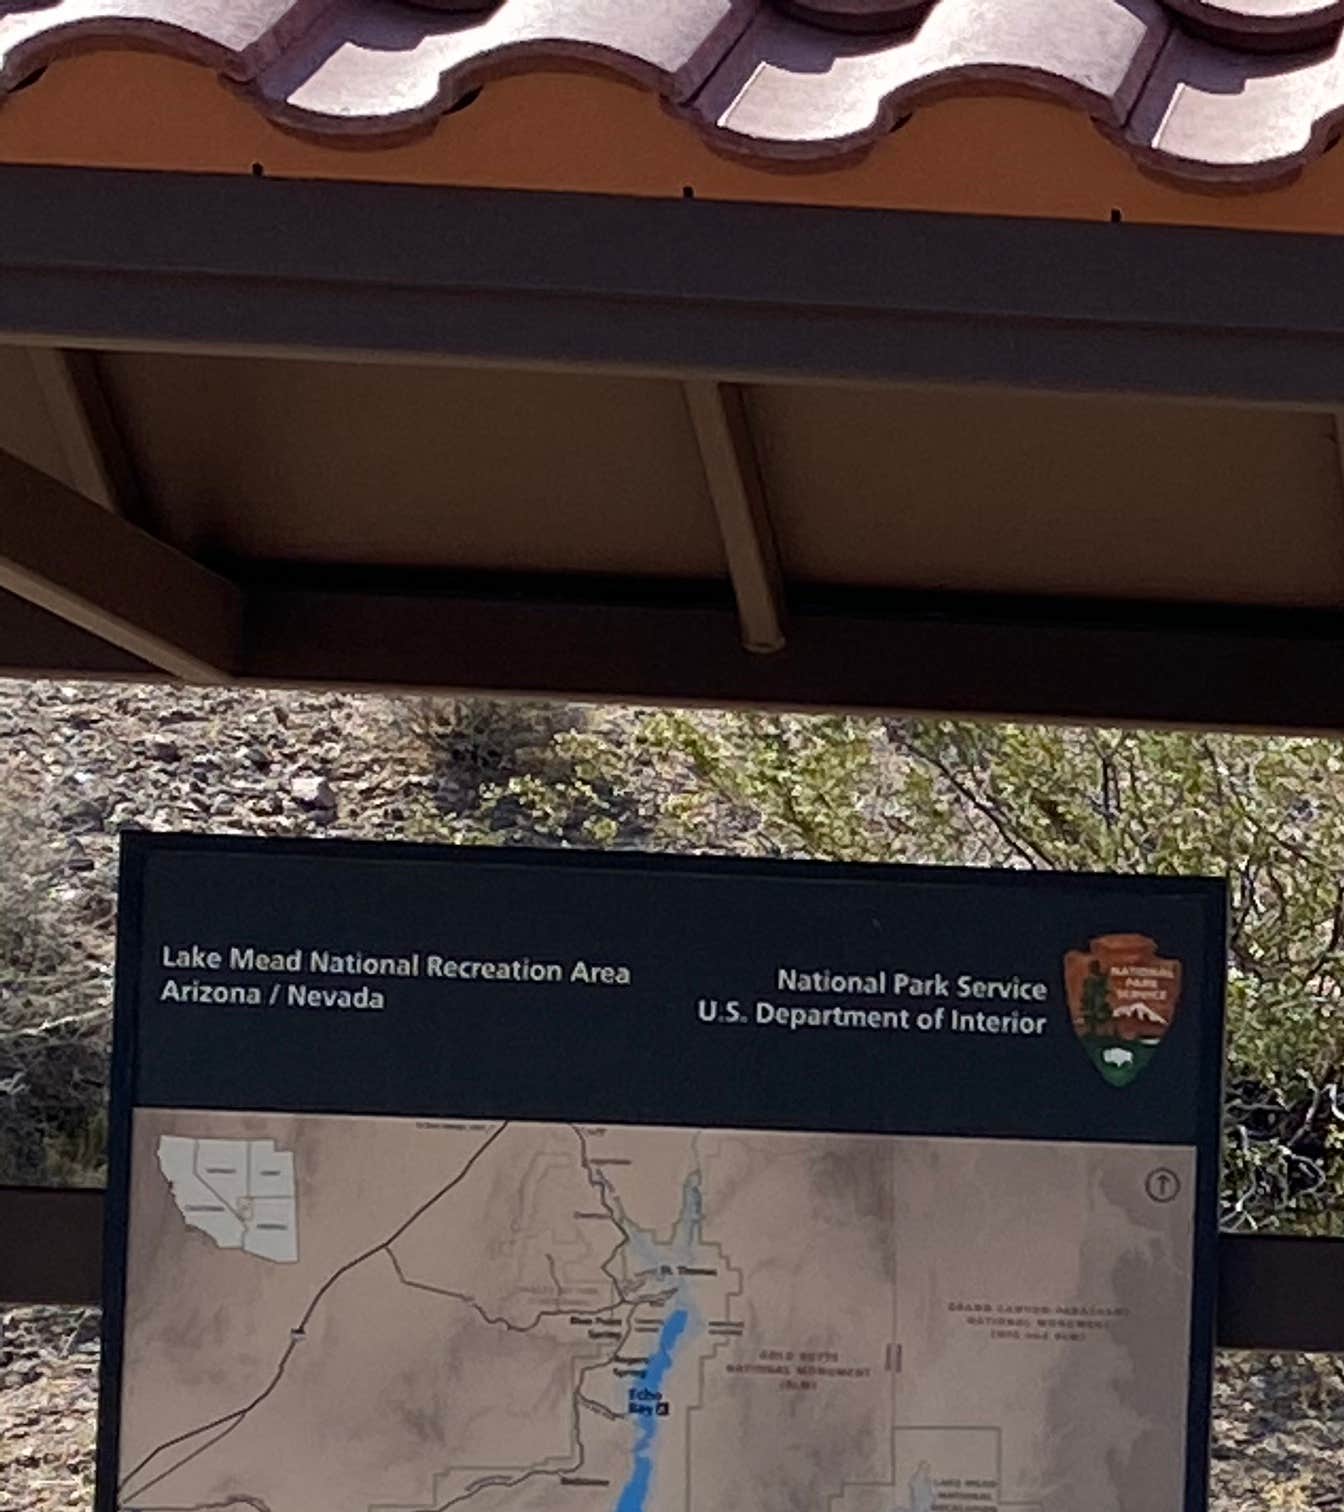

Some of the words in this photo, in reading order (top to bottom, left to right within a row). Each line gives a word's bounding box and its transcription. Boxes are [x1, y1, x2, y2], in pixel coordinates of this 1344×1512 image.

[162, 945, 221, 970] Lake
[230, 947, 300, 972] Mead
[310, 950, 419, 977] National
[427, 955, 562, 981] Recreation
[571, 961, 631, 984] Area
[160, 979, 261, 1005] Arizona
[287, 985, 384, 1009] Nevada
[778, 968, 886, 994] National
[894, 973, 949, 996] Park
[957, 977, 1048, 1000] Service
[698, 1000, 747, 1024] U.S.
[756, 1002, 909, 1031] Department
[916, 1007, 944, 1030] of
[951, 1009, 1047, 1035] Interior
